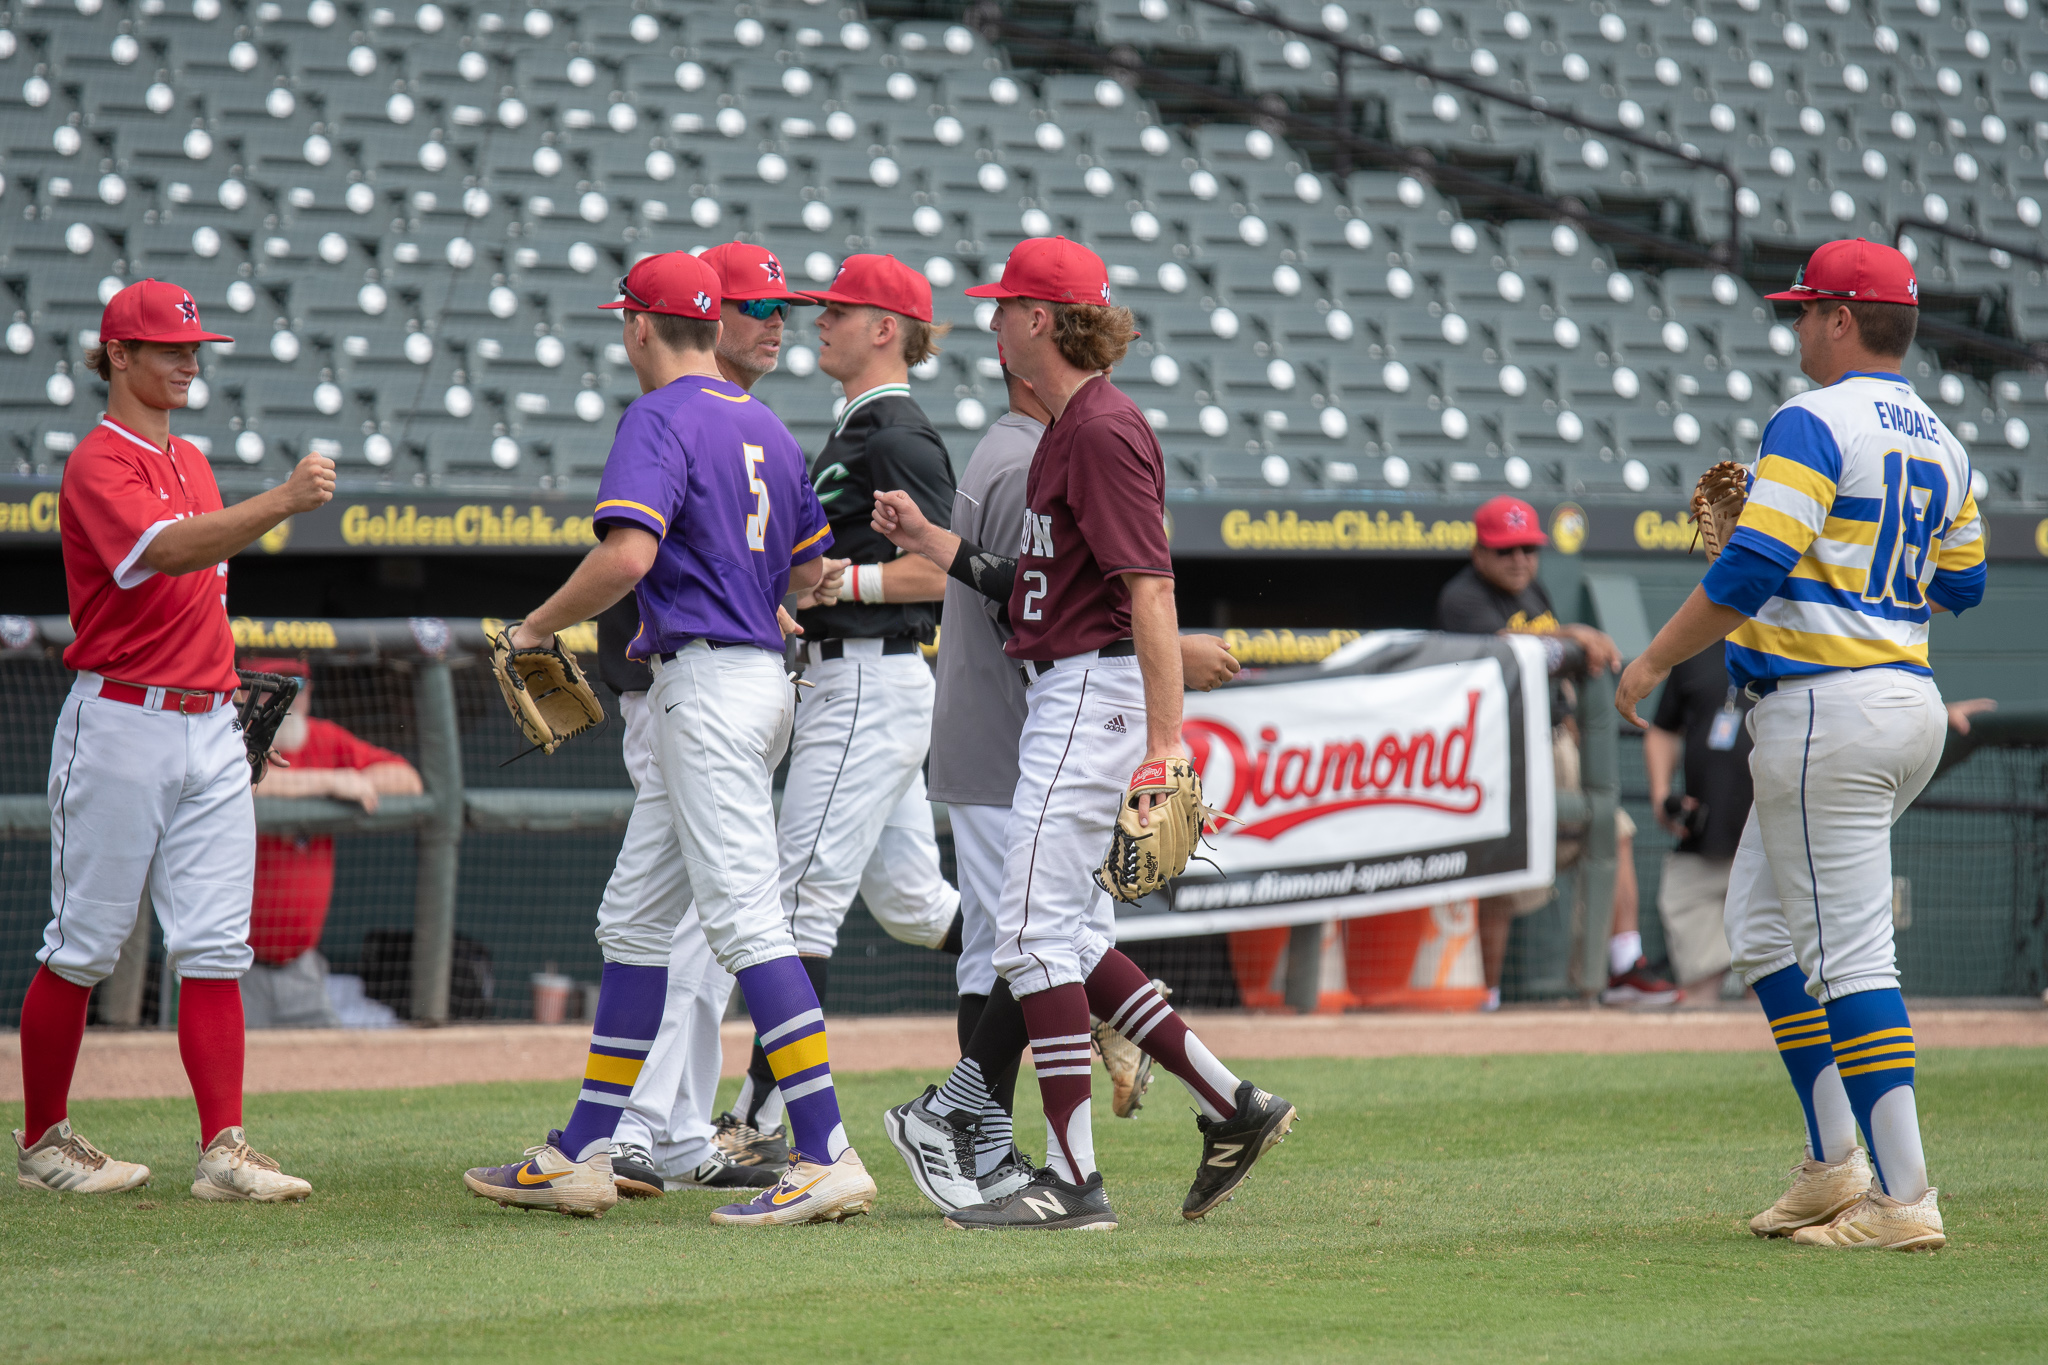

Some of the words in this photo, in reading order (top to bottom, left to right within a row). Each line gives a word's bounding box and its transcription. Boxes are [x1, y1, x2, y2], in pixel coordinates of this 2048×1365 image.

[1874, 401, 1940, 445] EVADALE
[743, 442, 770, 552] 5
[341, 504, 600, 547] GoldenChick.co
[1861, 448, 1949, 609] 18
[1023, 570, 1047, 620] 2
[1182, 689, 1481, 838] Diamond
[1144, 851, 1159, 884] Rawlings
[1174, 850, 1468, 912] www.diamond-sports.com
[1021, 1190, 1068, 1220] N
